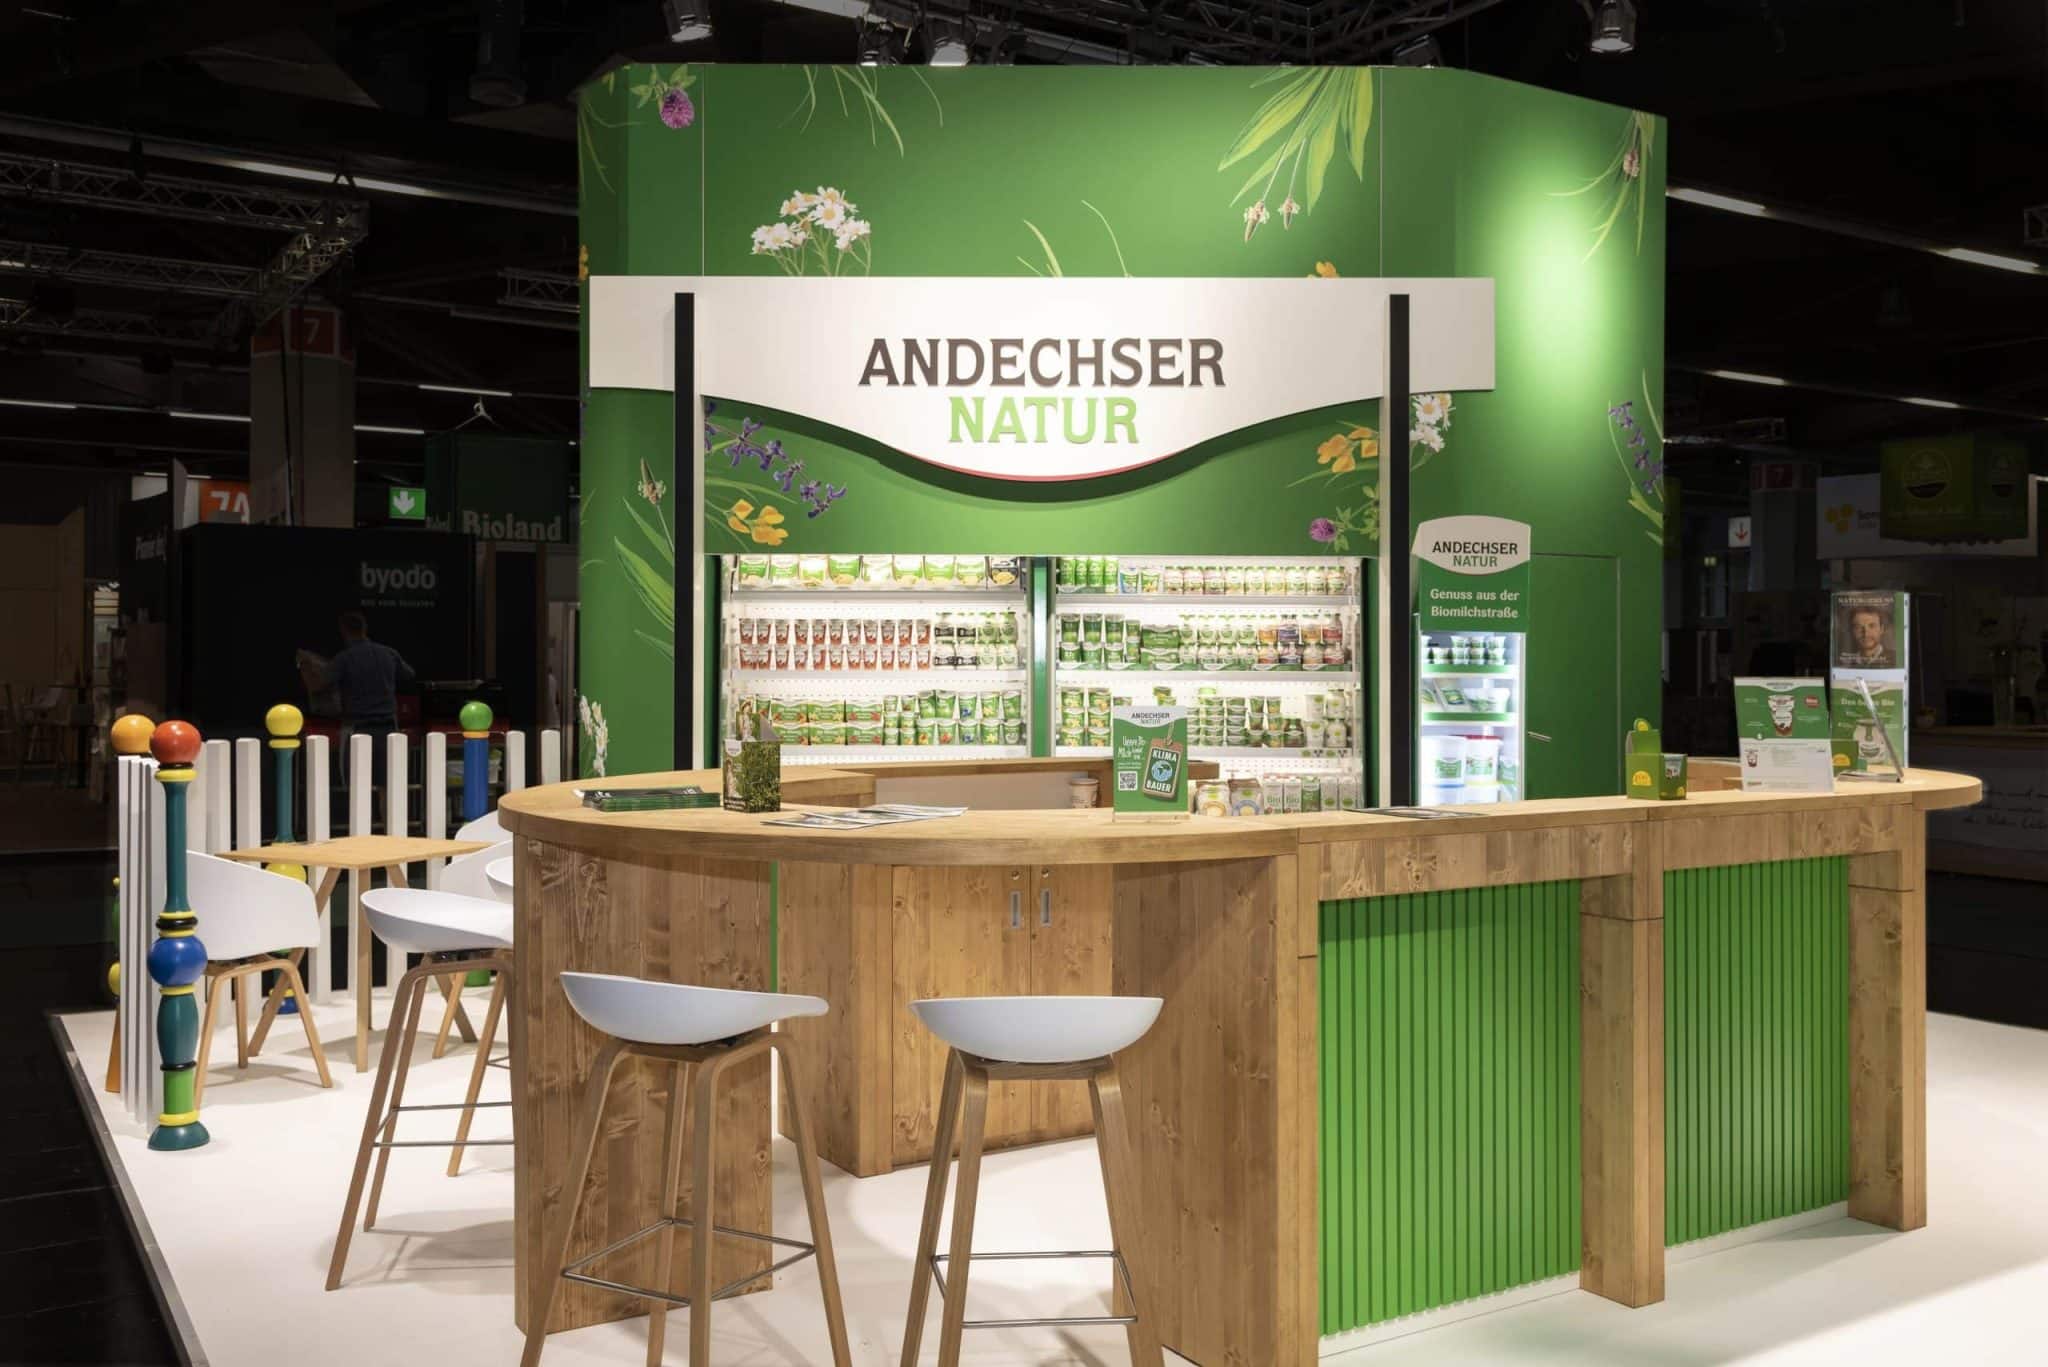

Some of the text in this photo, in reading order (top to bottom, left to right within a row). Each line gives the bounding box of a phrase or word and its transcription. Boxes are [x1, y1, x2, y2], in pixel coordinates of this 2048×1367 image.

[858, 338, 1226, 388] ANDECHSER
[948, 396, 1140, 444] NATUR
[1432, 541, 1518, 555] ANDECHSER
[1453, 555, 1498, 567] NATUR
[360, 560, 437, 594] byodo
[1430, 588, 1520, 601] Genuss aus der
[1431, 605, 1519, 618] Biomilchstraße
[1152, 749, 1177, 762] KLIMA
[1146, 781, 1172, 793] BAUER
